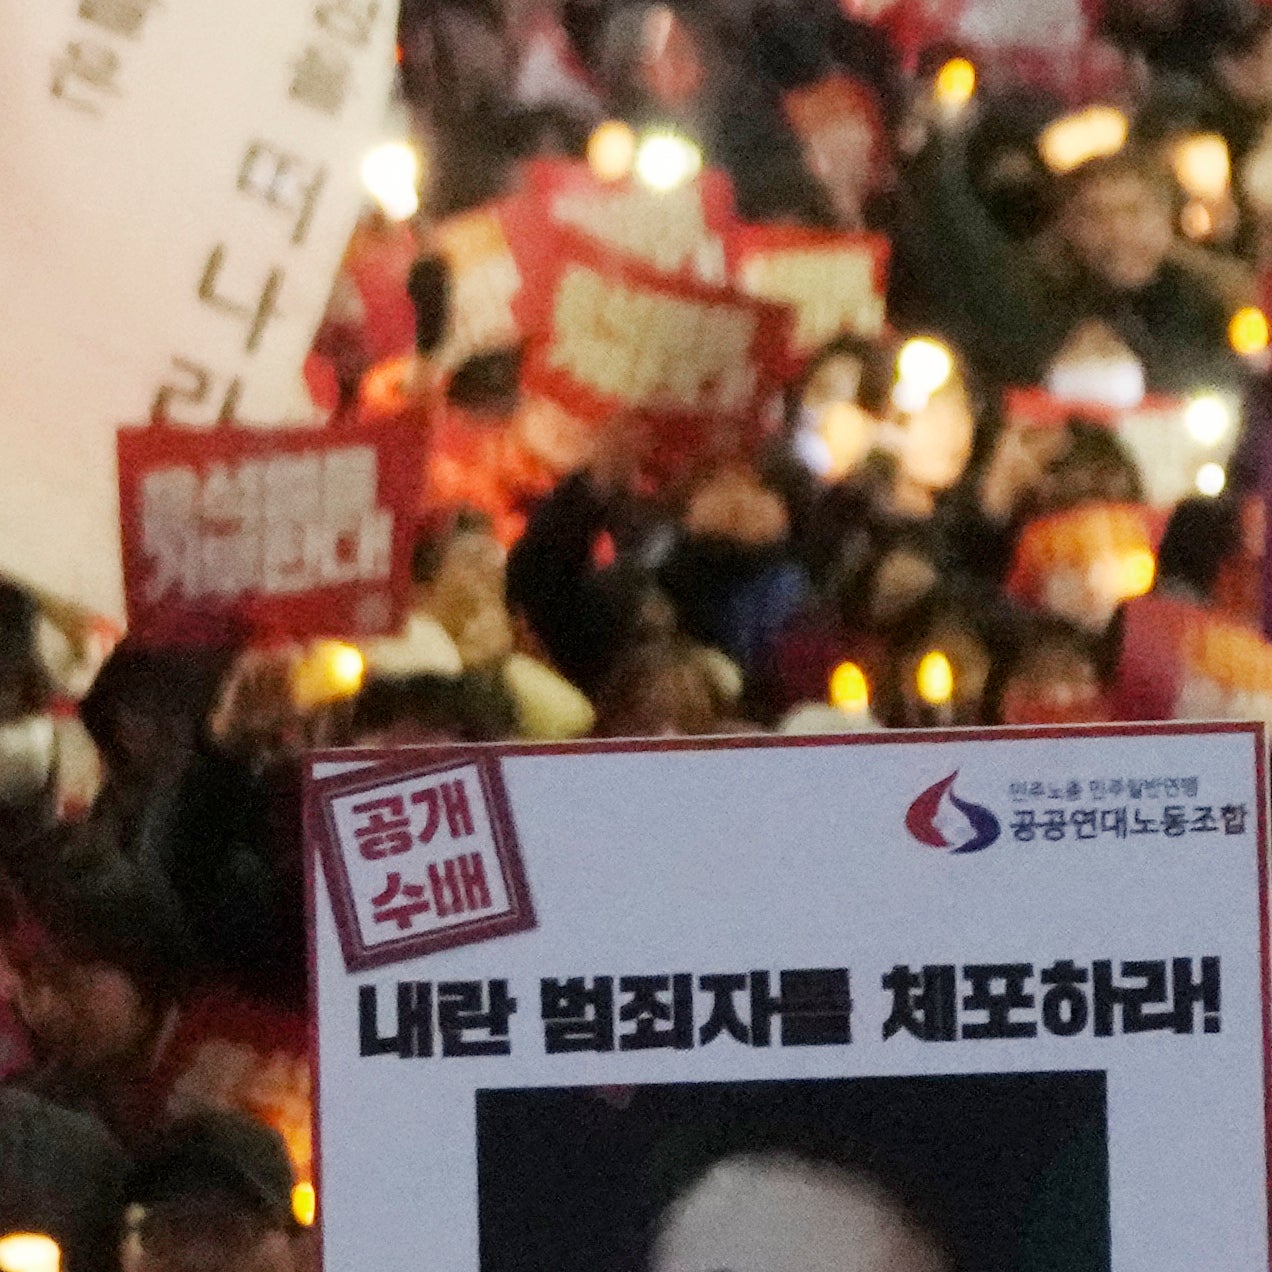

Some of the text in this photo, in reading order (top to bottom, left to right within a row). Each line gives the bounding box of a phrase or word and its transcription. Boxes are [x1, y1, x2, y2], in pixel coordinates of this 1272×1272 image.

[352, 778, 475, 861] 공개
[1009, 803, 1248, 842] 공공연대노동조합
[371, 852, 493, 930] 수배
[358, 956, 1222, 1058] 내란 범죄자를 체포하라!
